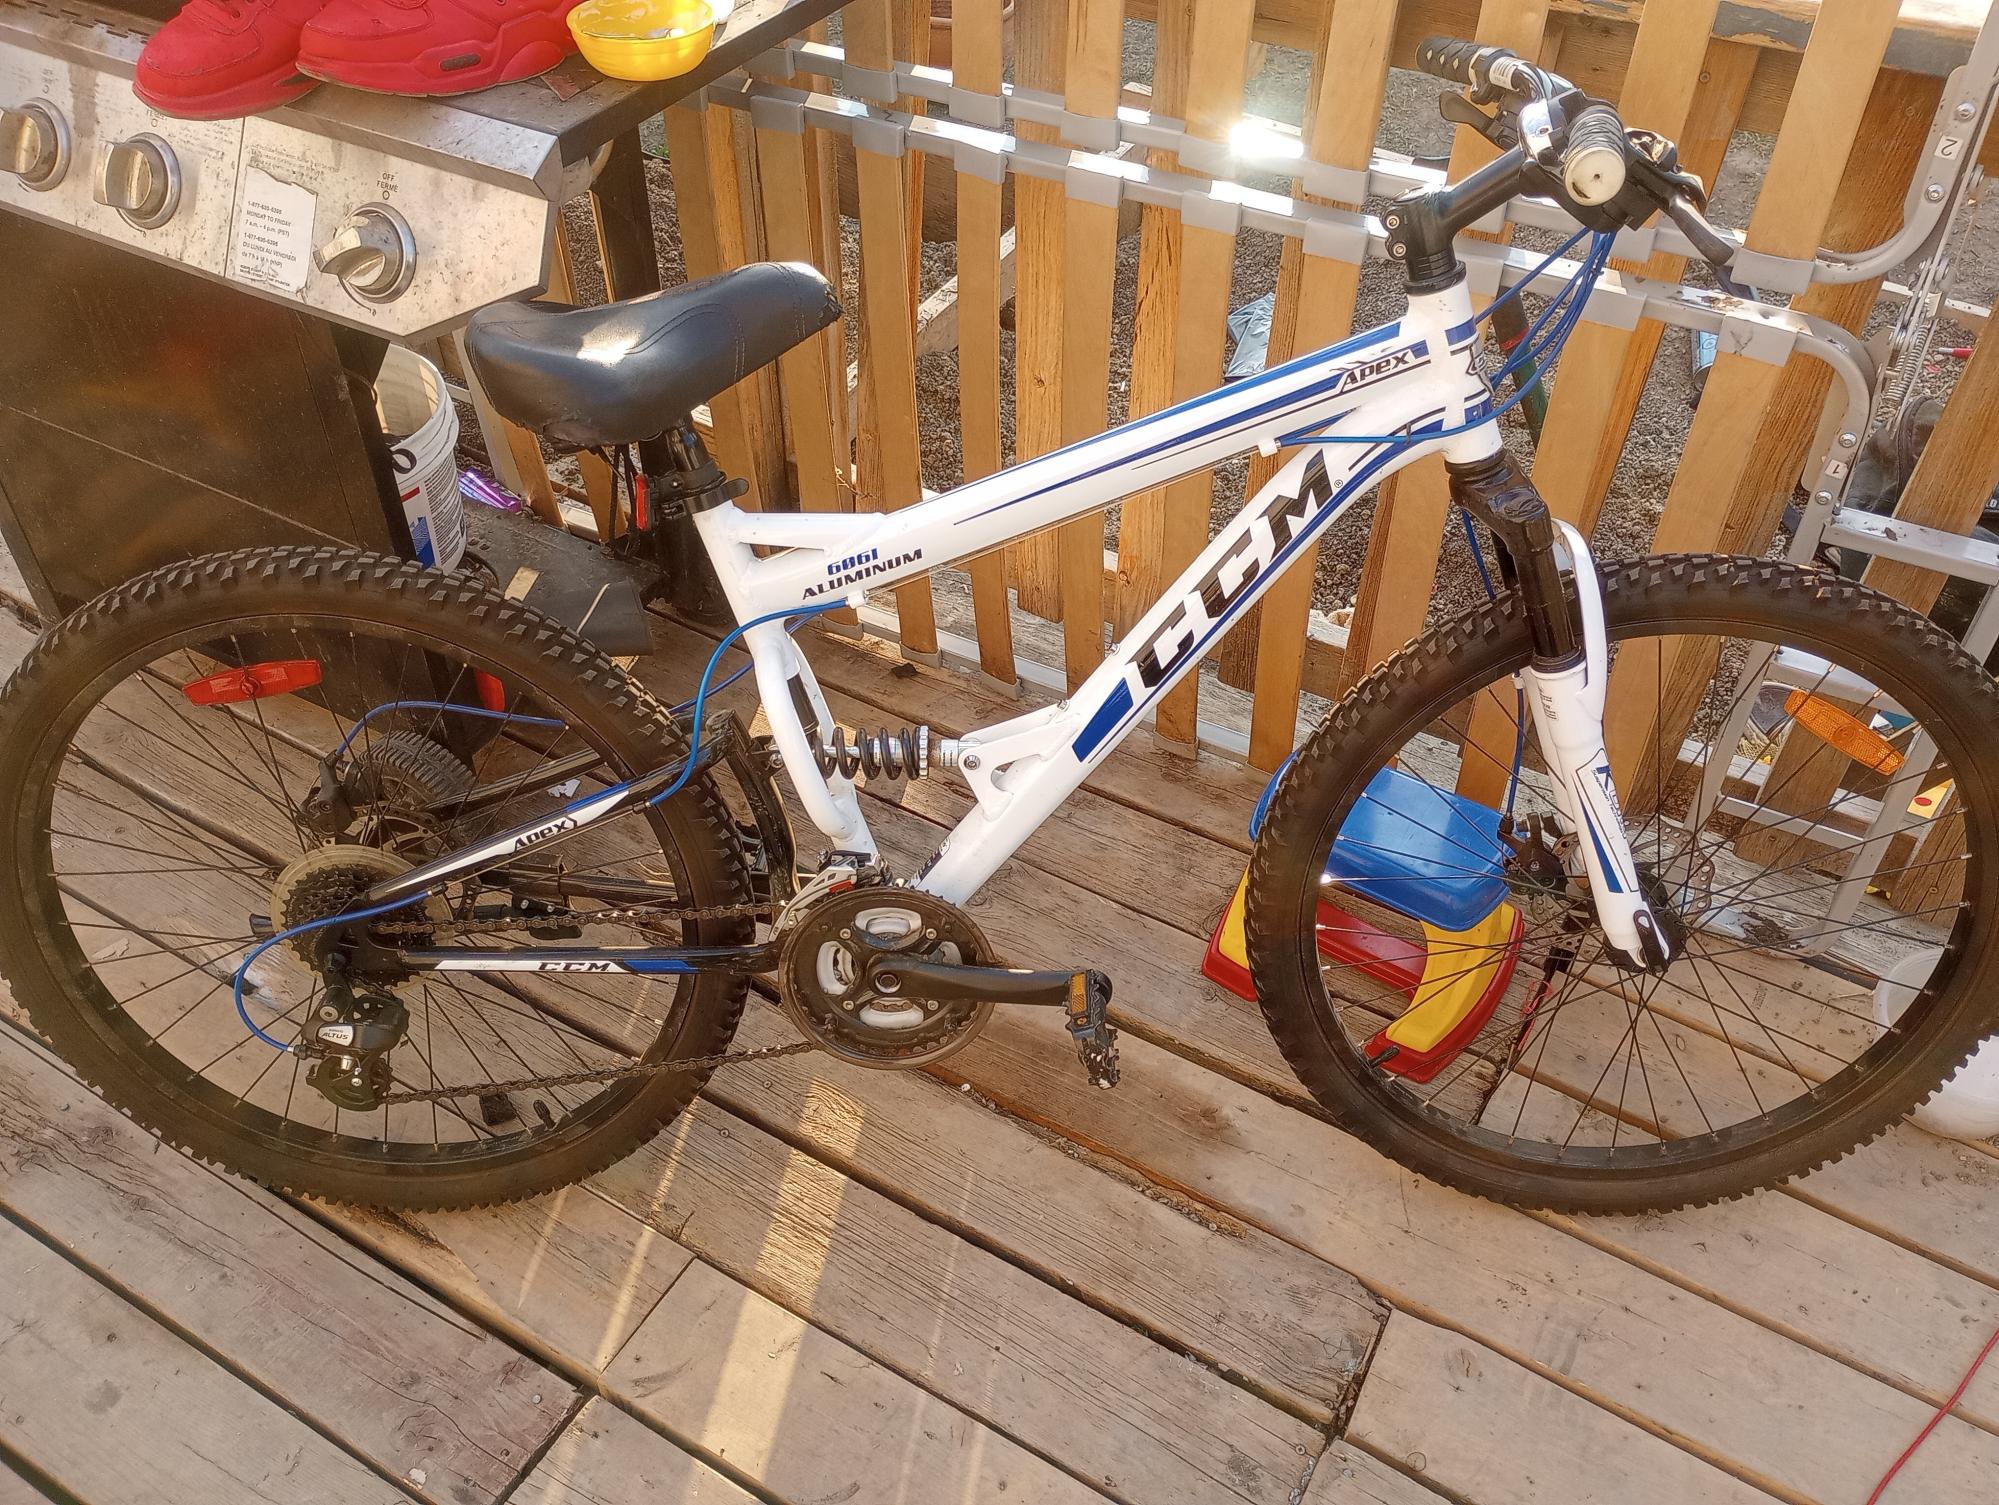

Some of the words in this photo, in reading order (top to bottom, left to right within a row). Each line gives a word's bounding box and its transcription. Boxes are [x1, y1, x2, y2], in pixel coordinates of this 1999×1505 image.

[1941, 138, 1957, 156] 2
[382, 172, 395, 181] OFF
[376, 180, 399, 193] FERMÉ
[246, 210, 266, 220] MONDAY
[274, 217, 291, 227] FRIDAY
[250, 243, 265, 252] LUNDI
[265, 247, 273, 255] AU
[827, 548, 879, 576] 6061
[1125, 448, 1333, 688] CCM
[802, 548, 923, 600] ALUMINUM
[538, 962, 611, 972] CCM
[321, 1032, 350, 1040] ALTUS
